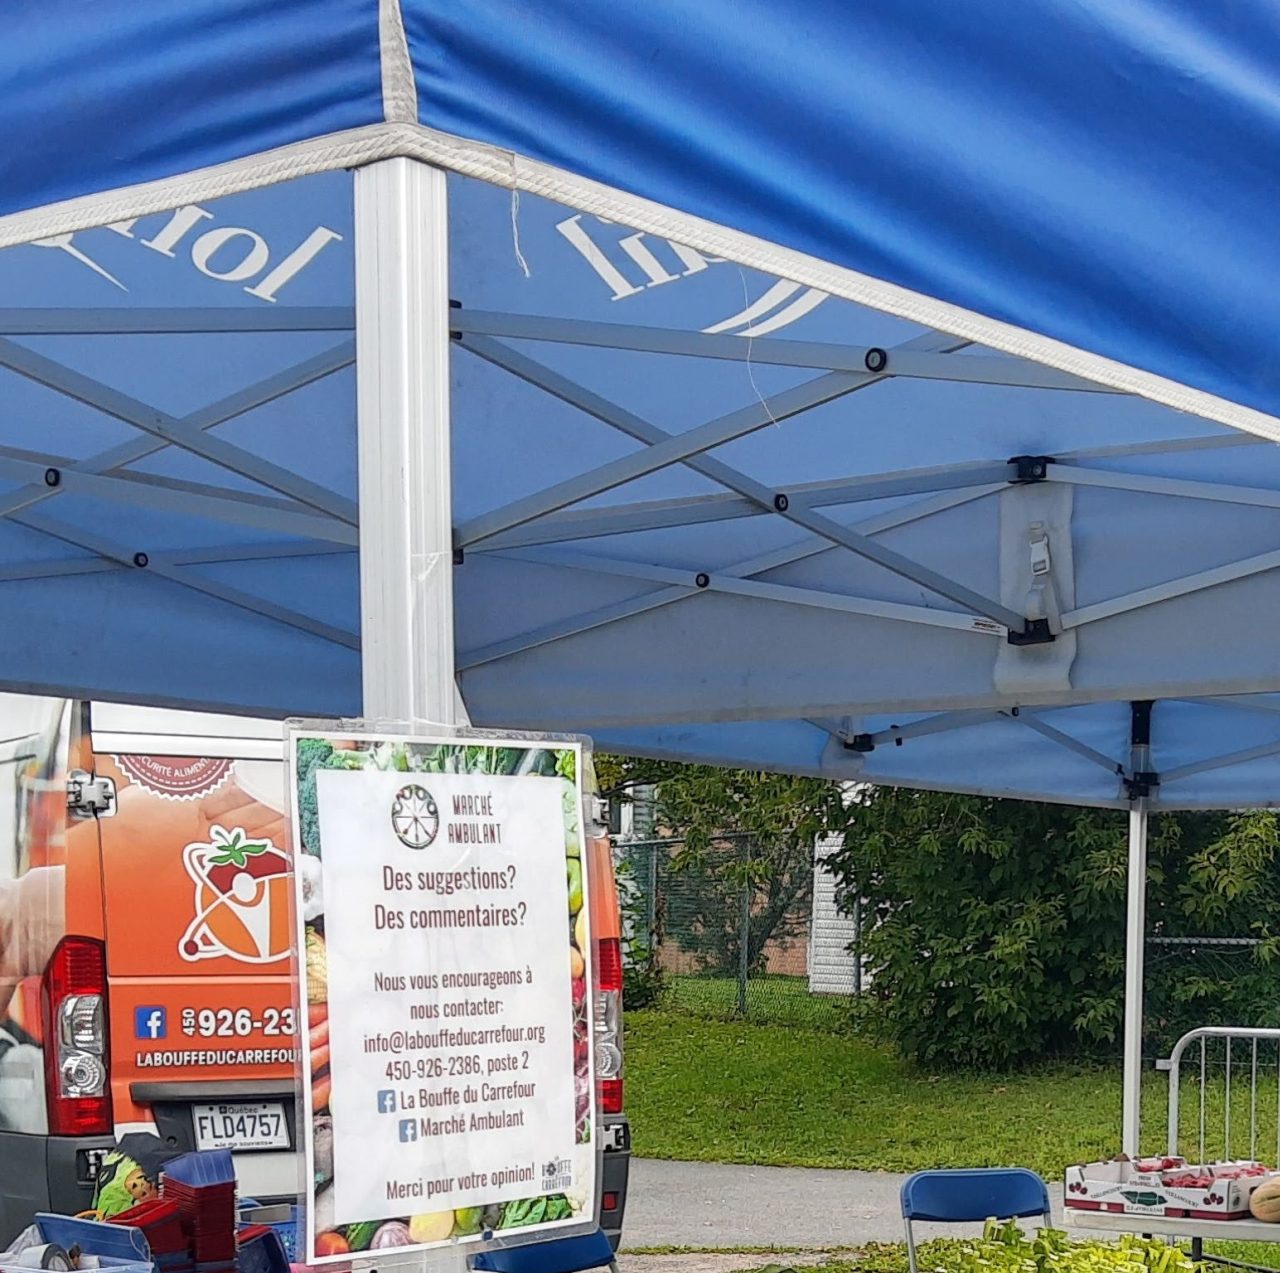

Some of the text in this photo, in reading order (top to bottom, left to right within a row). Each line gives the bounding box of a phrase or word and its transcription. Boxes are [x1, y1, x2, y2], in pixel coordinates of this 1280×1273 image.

[138, 755, 210, 777] CURITÉ ALIMENT
[452, 791, 494, 816] MARCHÉ
[447, 823, 502, 844] AMBULANT
[383, 864, 516, 895] Des suggestions?
[374, 901, 527, 930] Des commentaires?
[374, 965, 533, 992] Nous vous encourageons à
[182, 1008, 299, 1037] 450 926-23
[410, 998, 504, 1020] nous contacter:
[363, 1024, 546, 1054] info@labouffeducarrefour.org
[385, 1050, 530, 1081] 450-926-2386, poste 2
[400, 1081, 536, 1110] La Bouffe du Carrefour
[198, 1114, 281, 1140] FLD4757
[420, 1109, 525, 1137] Marché Ambulant
[386, 1162, 536, 1201] Merci pour votre opinion!
